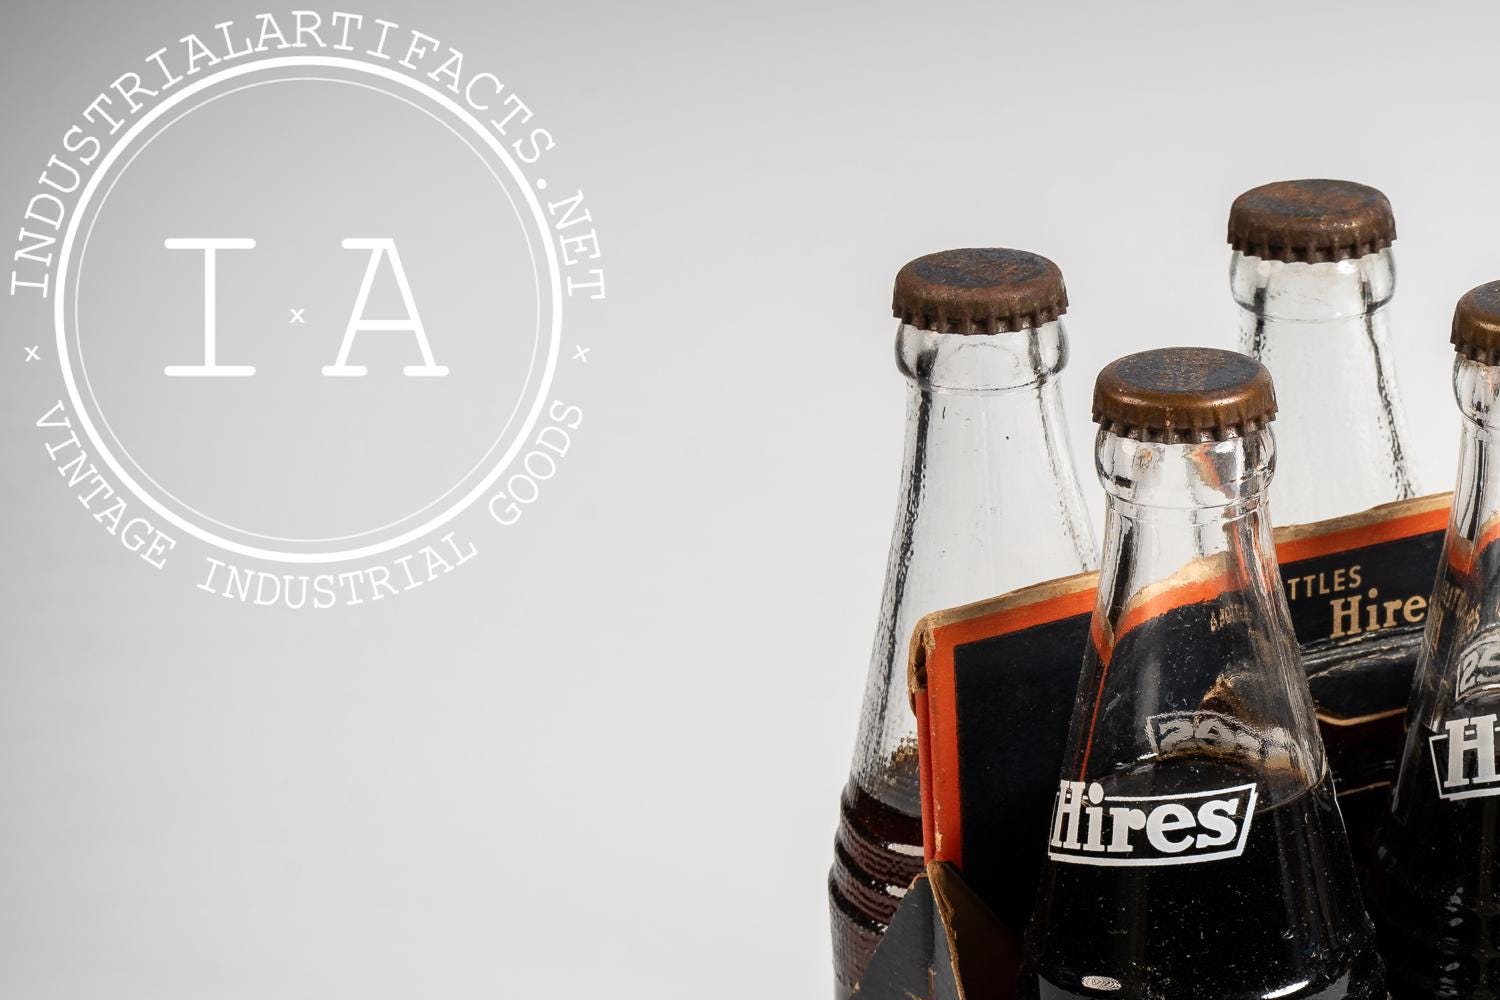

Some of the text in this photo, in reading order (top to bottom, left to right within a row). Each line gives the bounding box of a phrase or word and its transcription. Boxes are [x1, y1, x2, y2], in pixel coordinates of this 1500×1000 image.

[1287, 564, 1362, 601] TTLES
[1329, 587, 1428, 639] Hire
[1050, 780, 1240, 853] Hires
